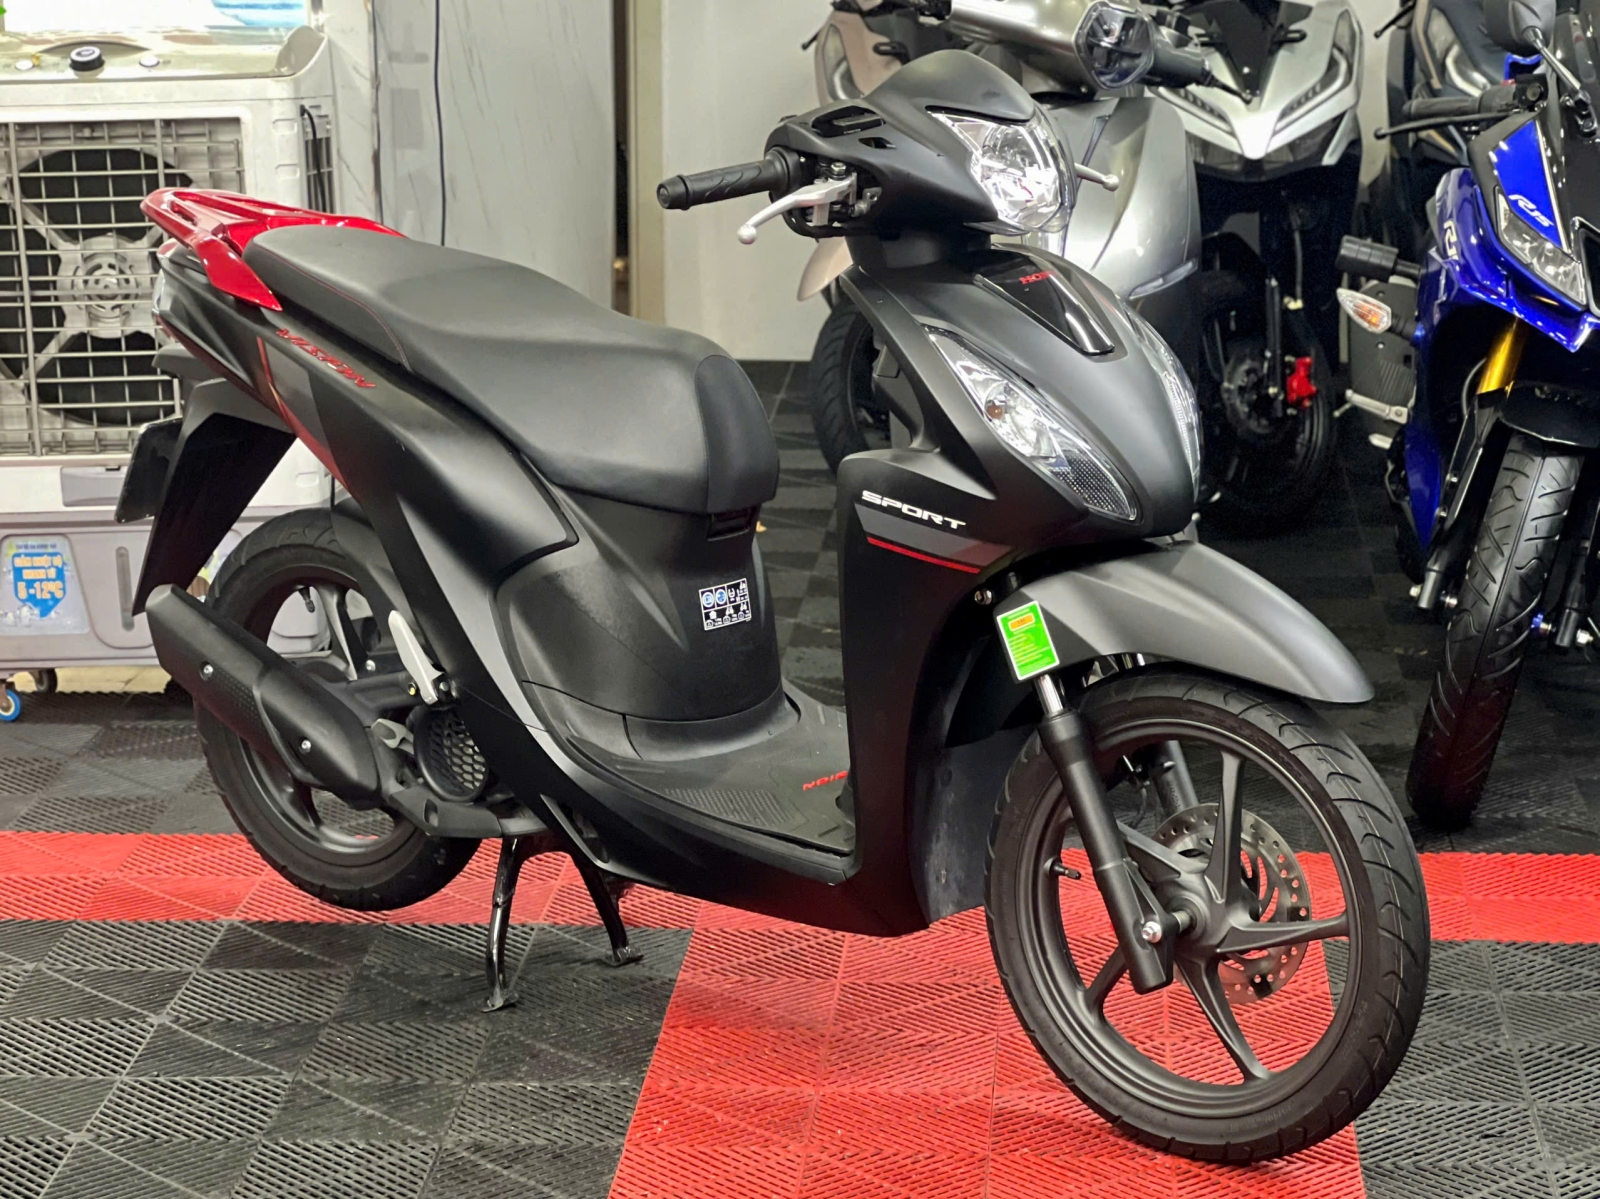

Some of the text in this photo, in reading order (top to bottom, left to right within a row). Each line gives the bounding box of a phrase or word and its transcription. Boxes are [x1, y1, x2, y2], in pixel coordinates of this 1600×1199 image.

[1508, 194, 1555, 227] R15
[275, 327, 377, 389] VISION
[861, 489, 967, 530] SPORT
